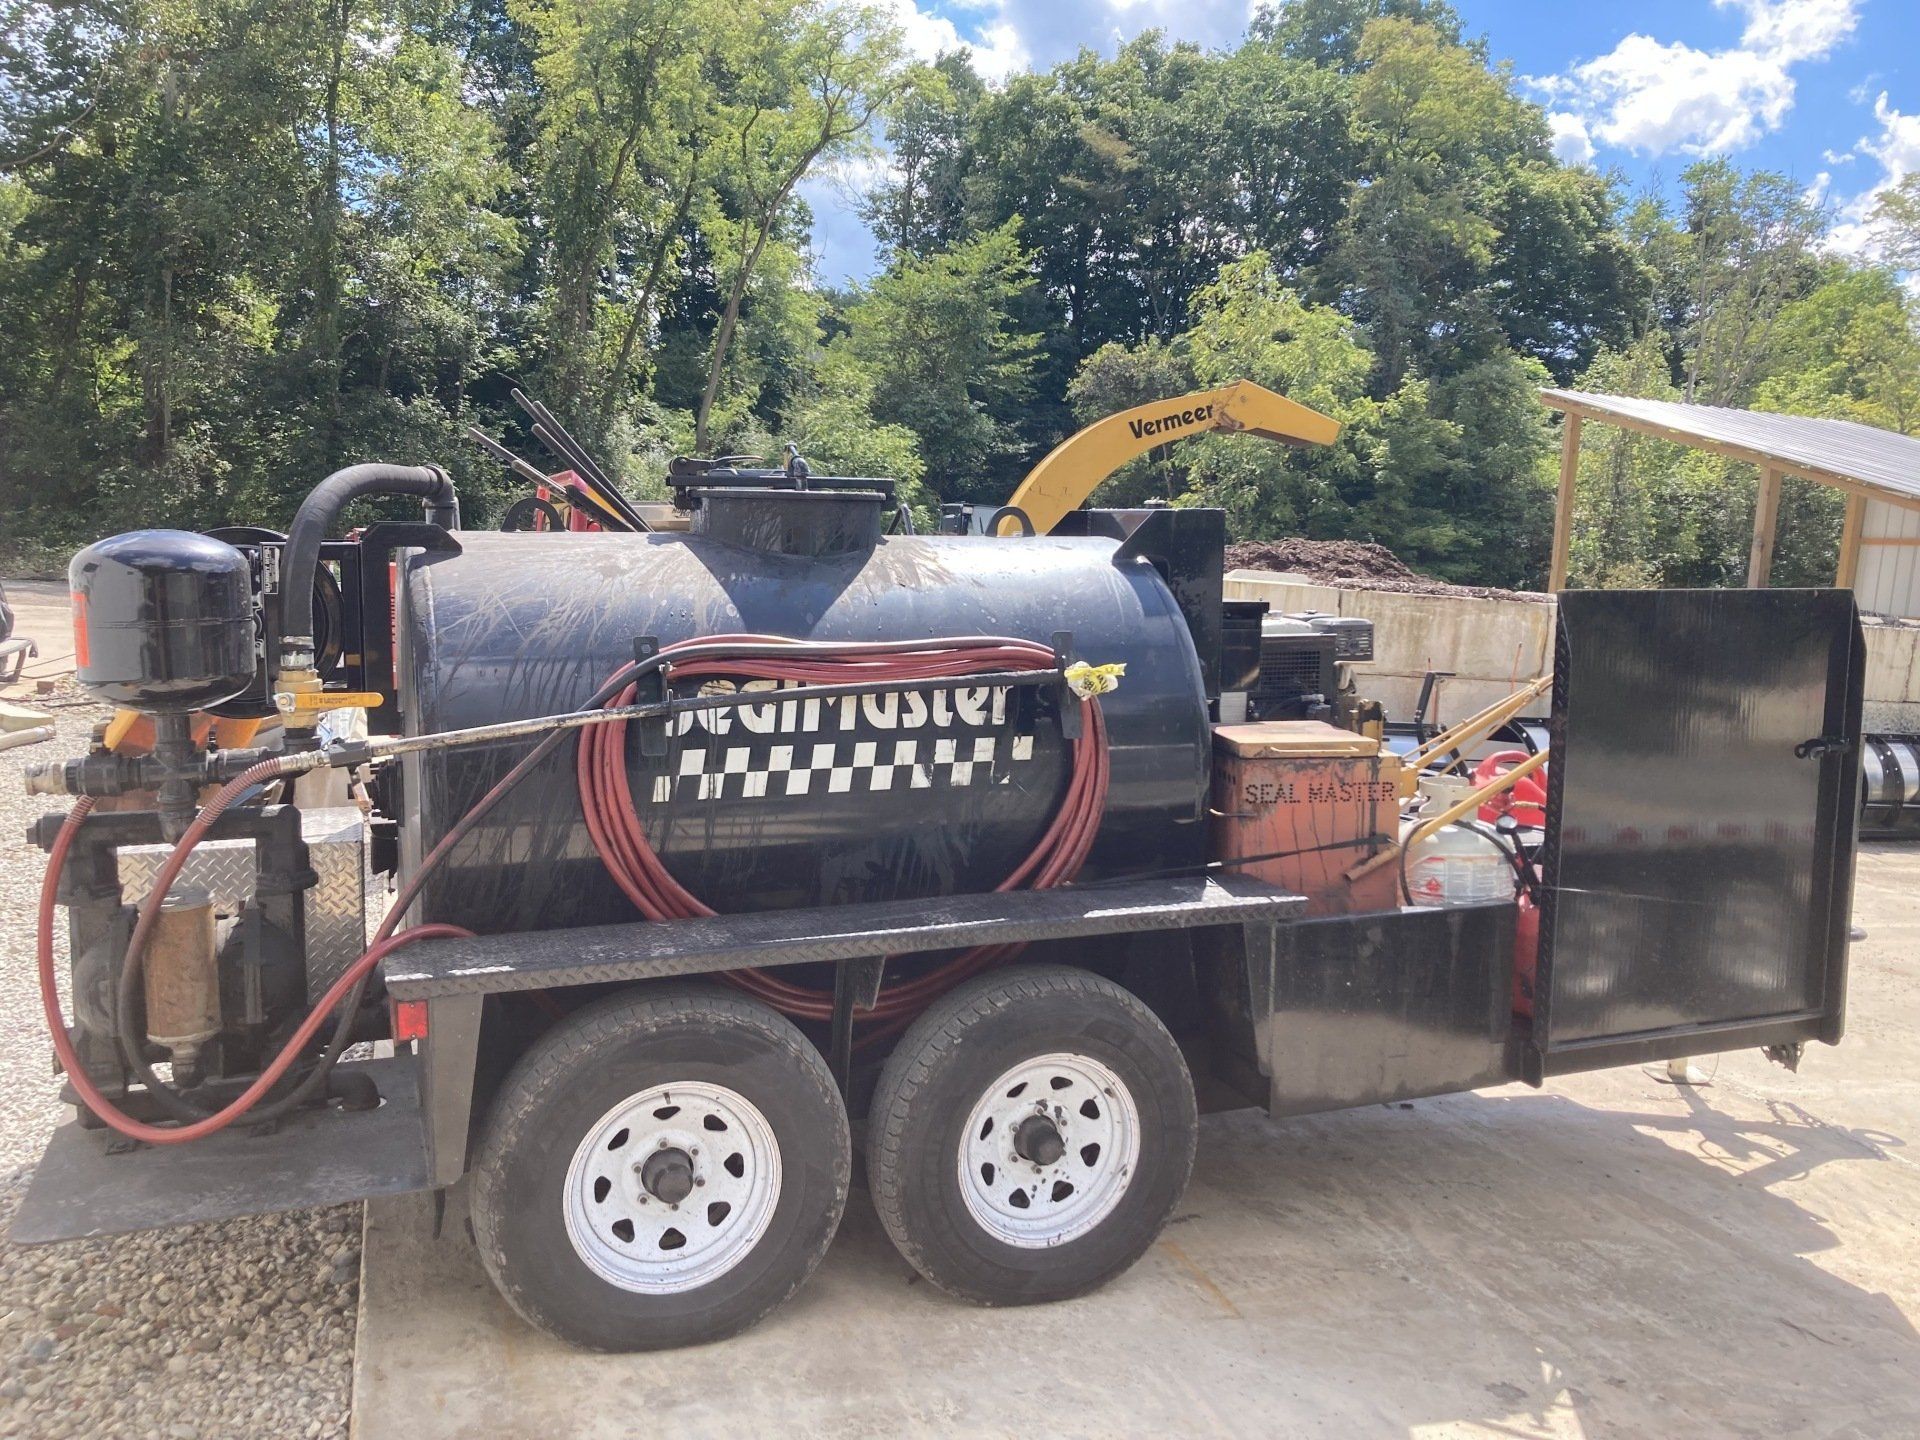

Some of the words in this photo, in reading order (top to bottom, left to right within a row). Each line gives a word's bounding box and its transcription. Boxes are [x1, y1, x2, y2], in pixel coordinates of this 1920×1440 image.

[1128, 404, 1213, 439] Vermeer
[1245, 783, 1300, 804] SEAL
[1308, 781, 1394, 803] MASTER
